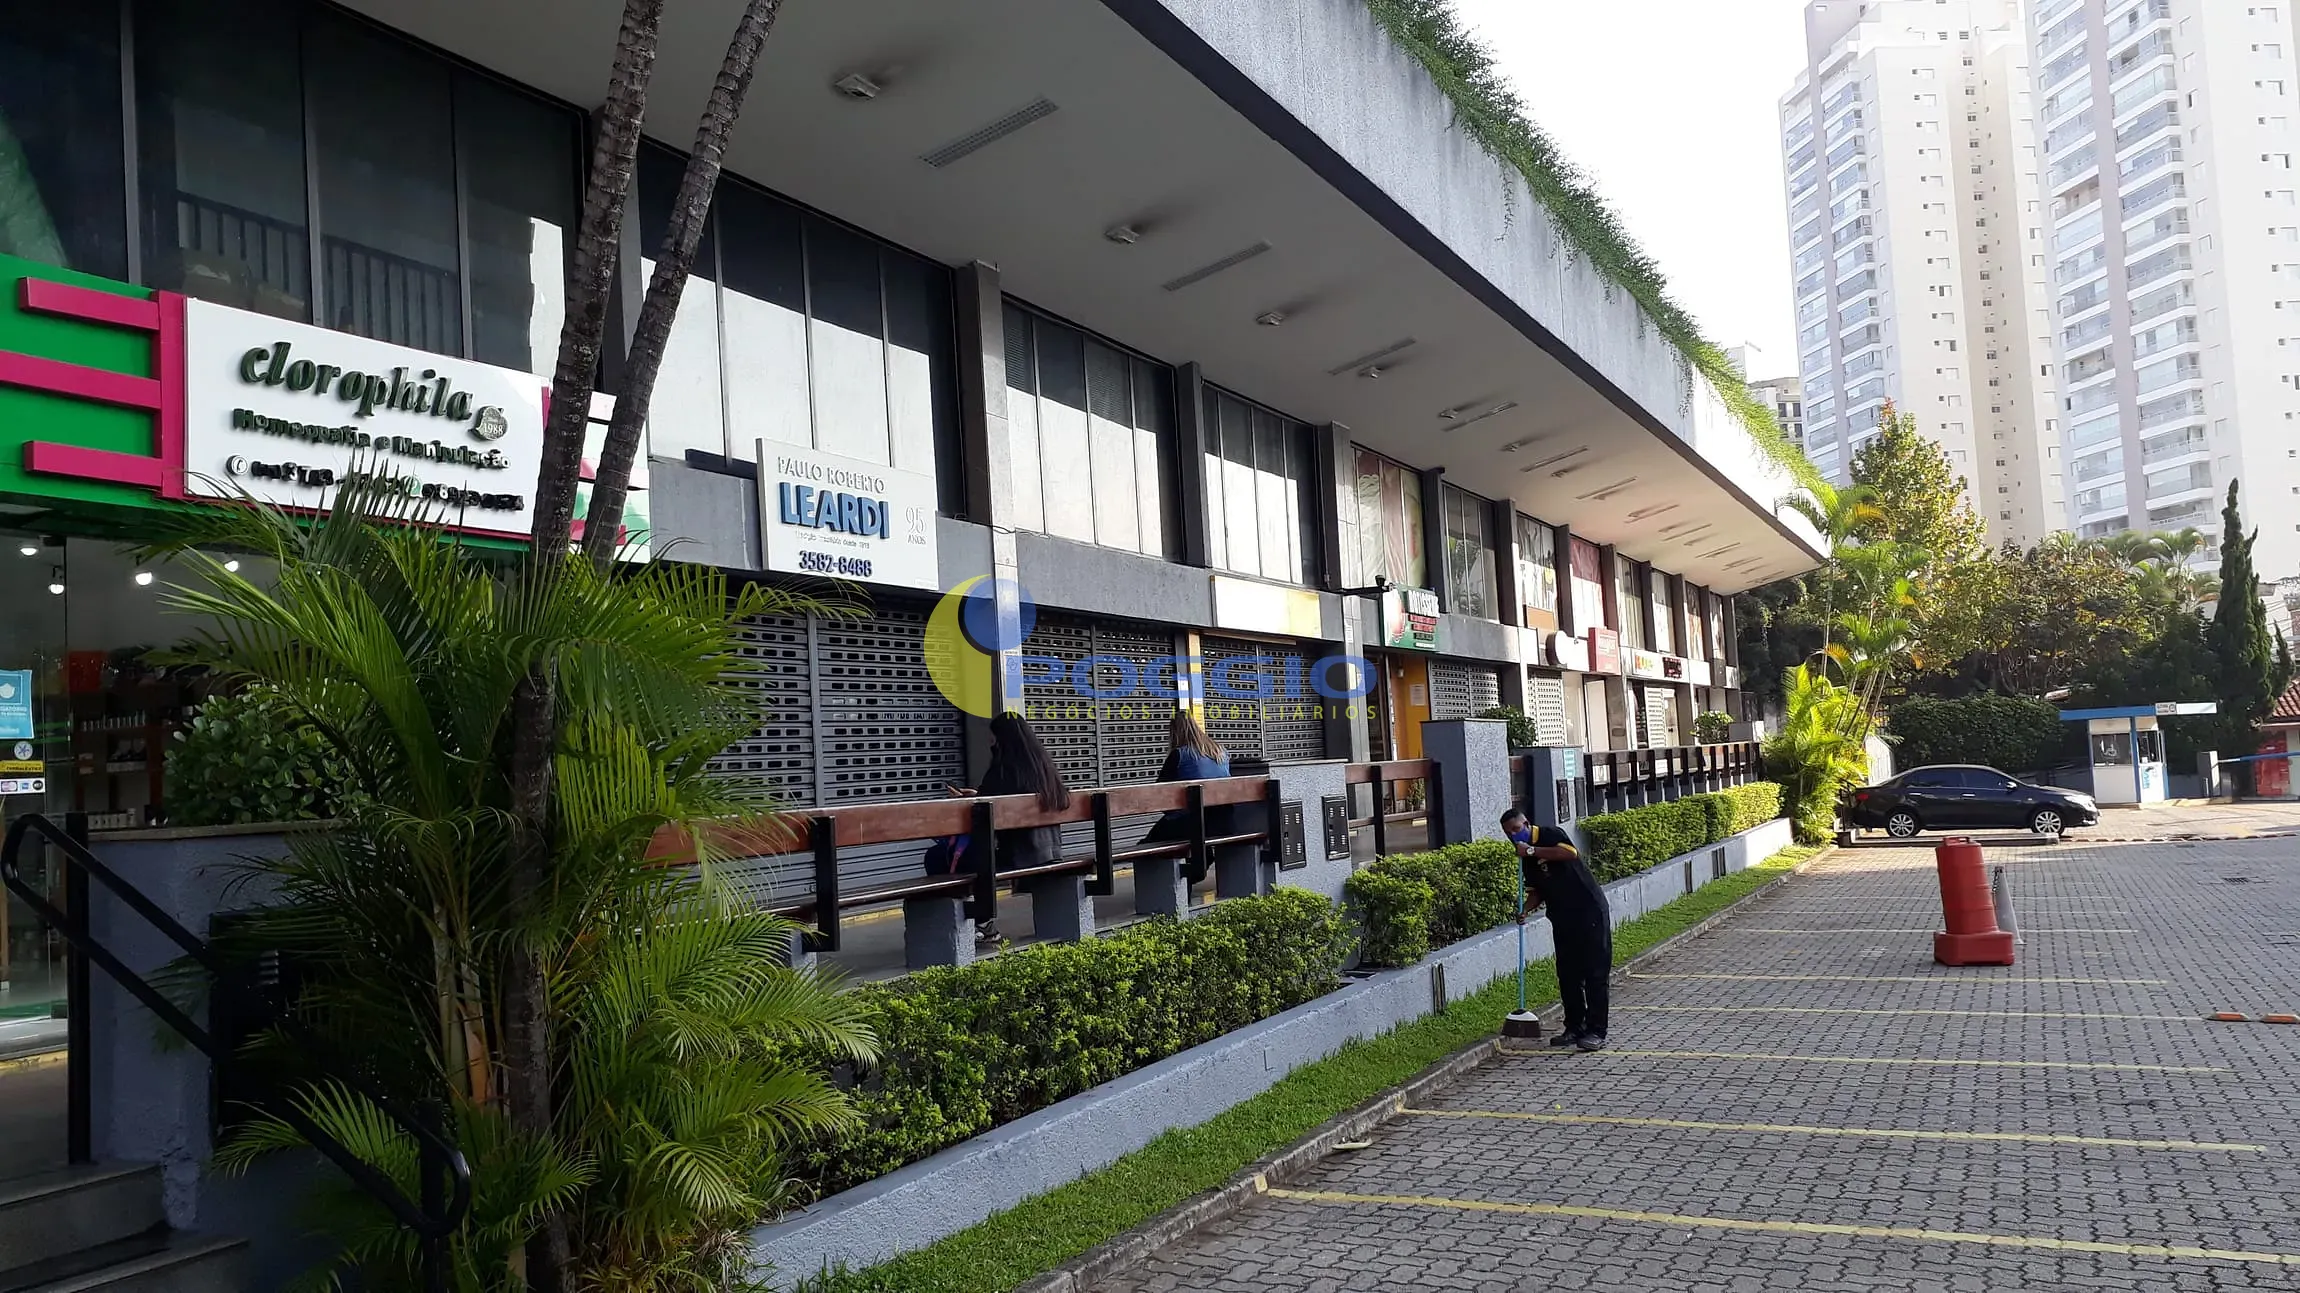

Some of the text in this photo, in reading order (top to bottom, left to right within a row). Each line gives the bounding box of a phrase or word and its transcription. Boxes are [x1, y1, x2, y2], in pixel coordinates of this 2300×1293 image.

[239, 341, 474, 421] clorophila
[233, 408, 512, 469] Homeopatia e Manipulação
[483, 422, 505, 436] 1988
[777, 456, 885, 493] PAULO ROBERTO
[779, 482, 890, 540] LEARDI
